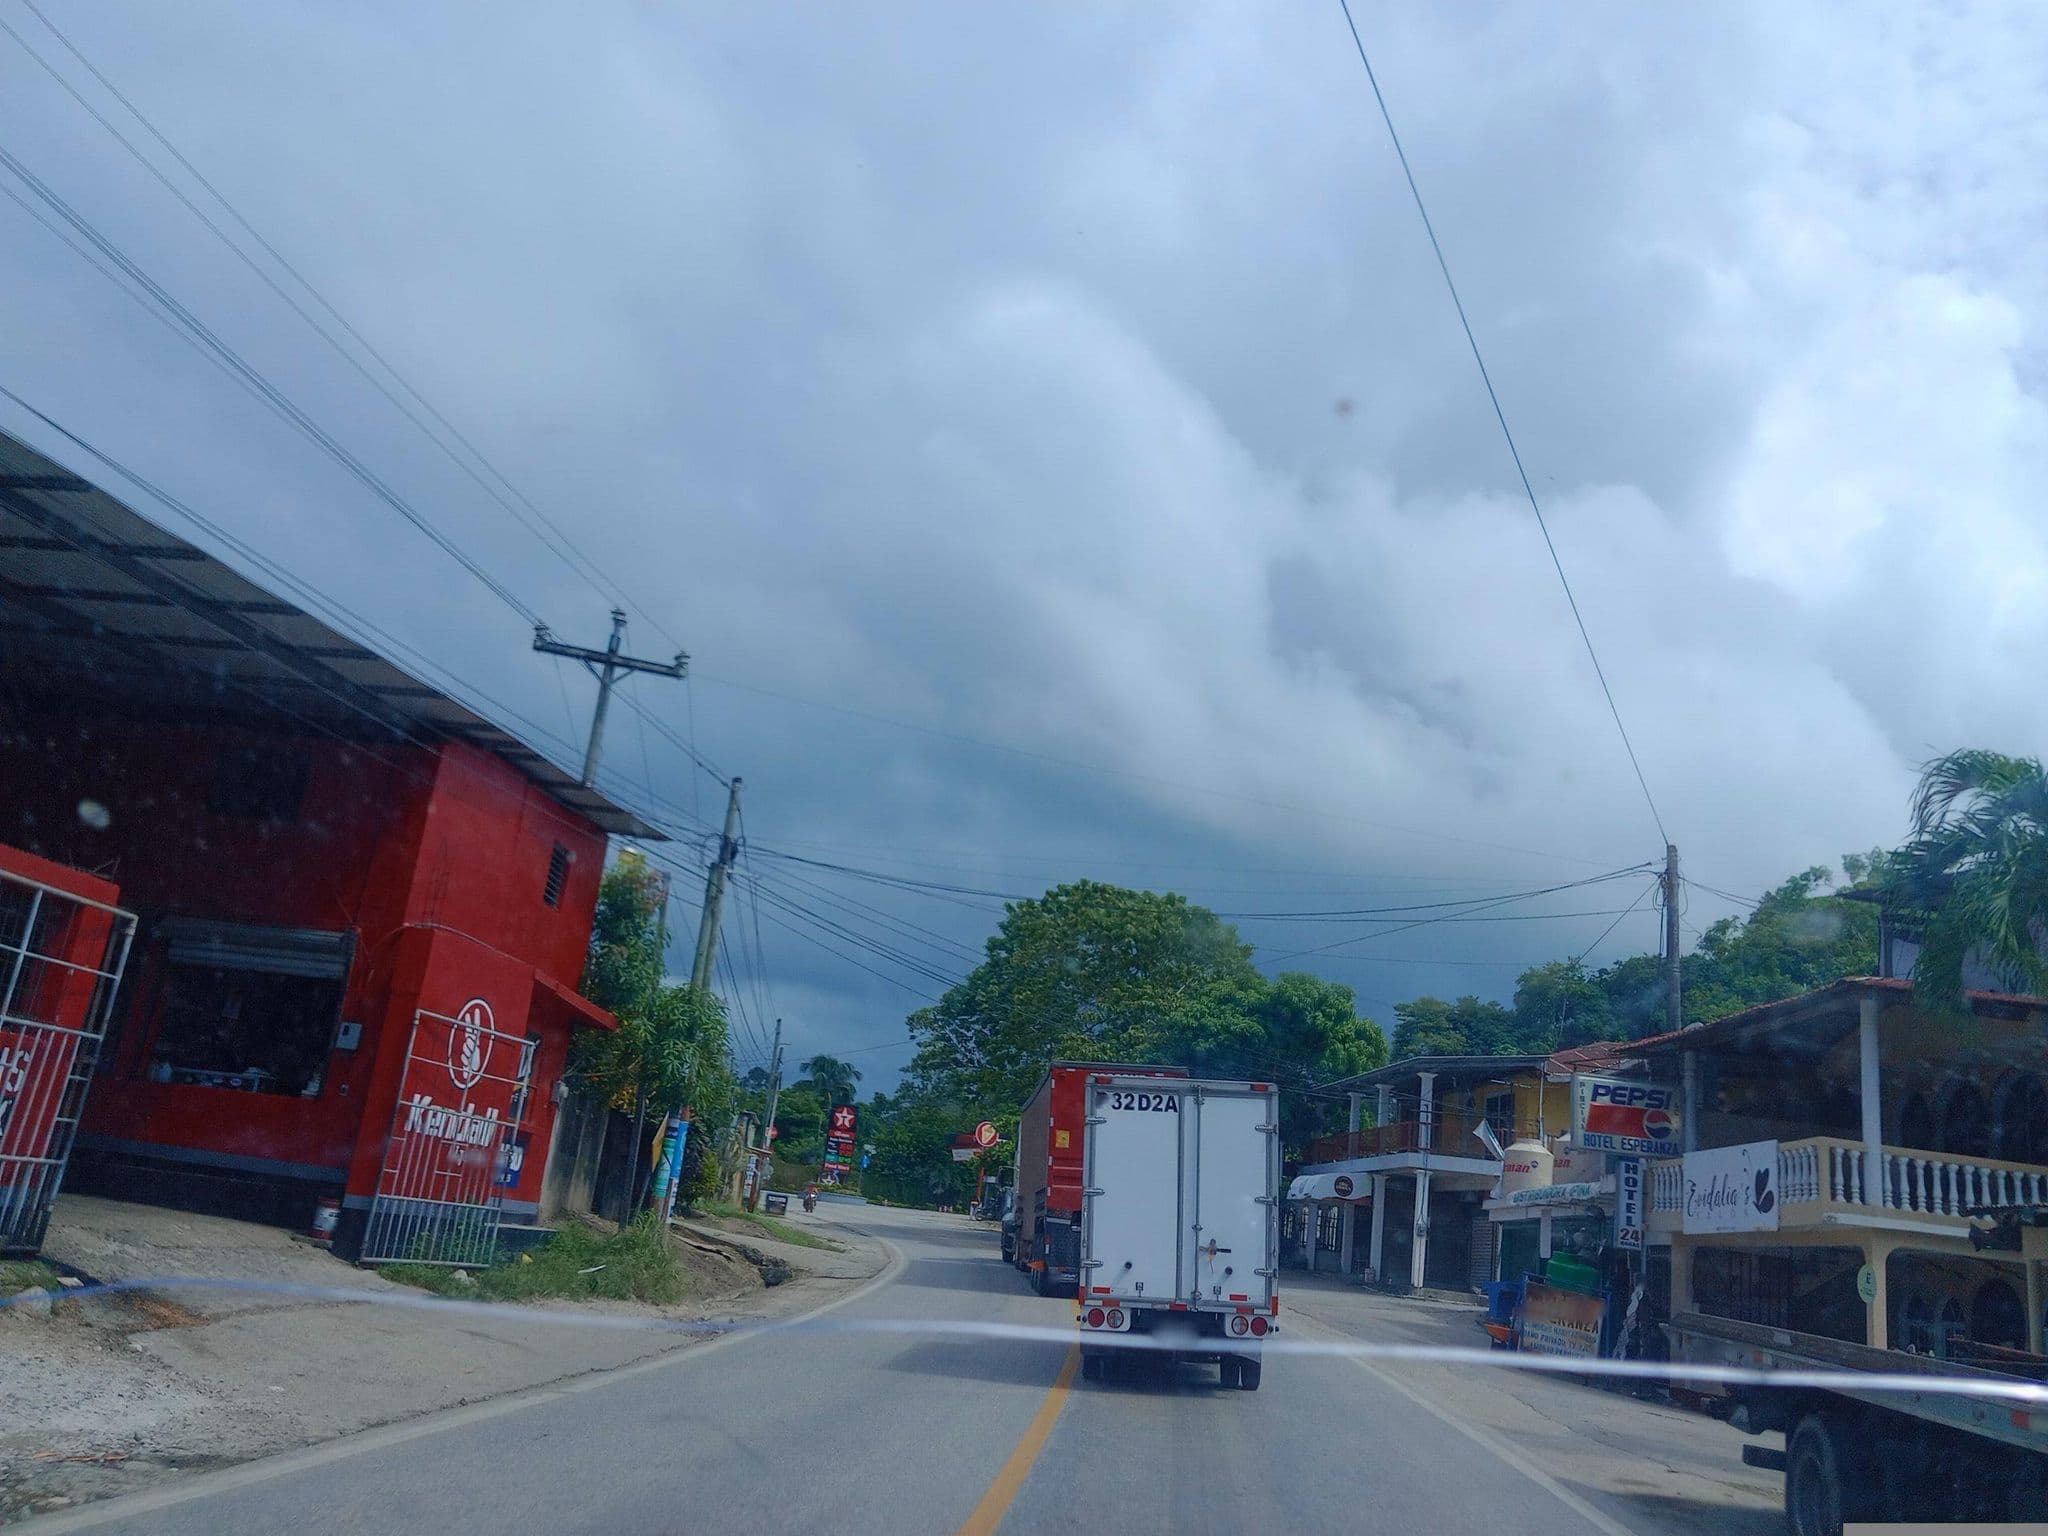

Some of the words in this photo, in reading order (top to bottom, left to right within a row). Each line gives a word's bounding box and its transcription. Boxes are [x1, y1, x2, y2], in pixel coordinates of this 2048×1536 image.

[1590, 1083, 1673, 1109] PEPSI
[404, 1094, 499, 1147] Kendall
[1584, 1133, 1617, 1149] HOTEL
[1621, 1137, 1681, 1155] ESPERANZA
[1624, 1163, 1638, 1227] HOTEL
[1620, 1227, 1640, 1242] 24
